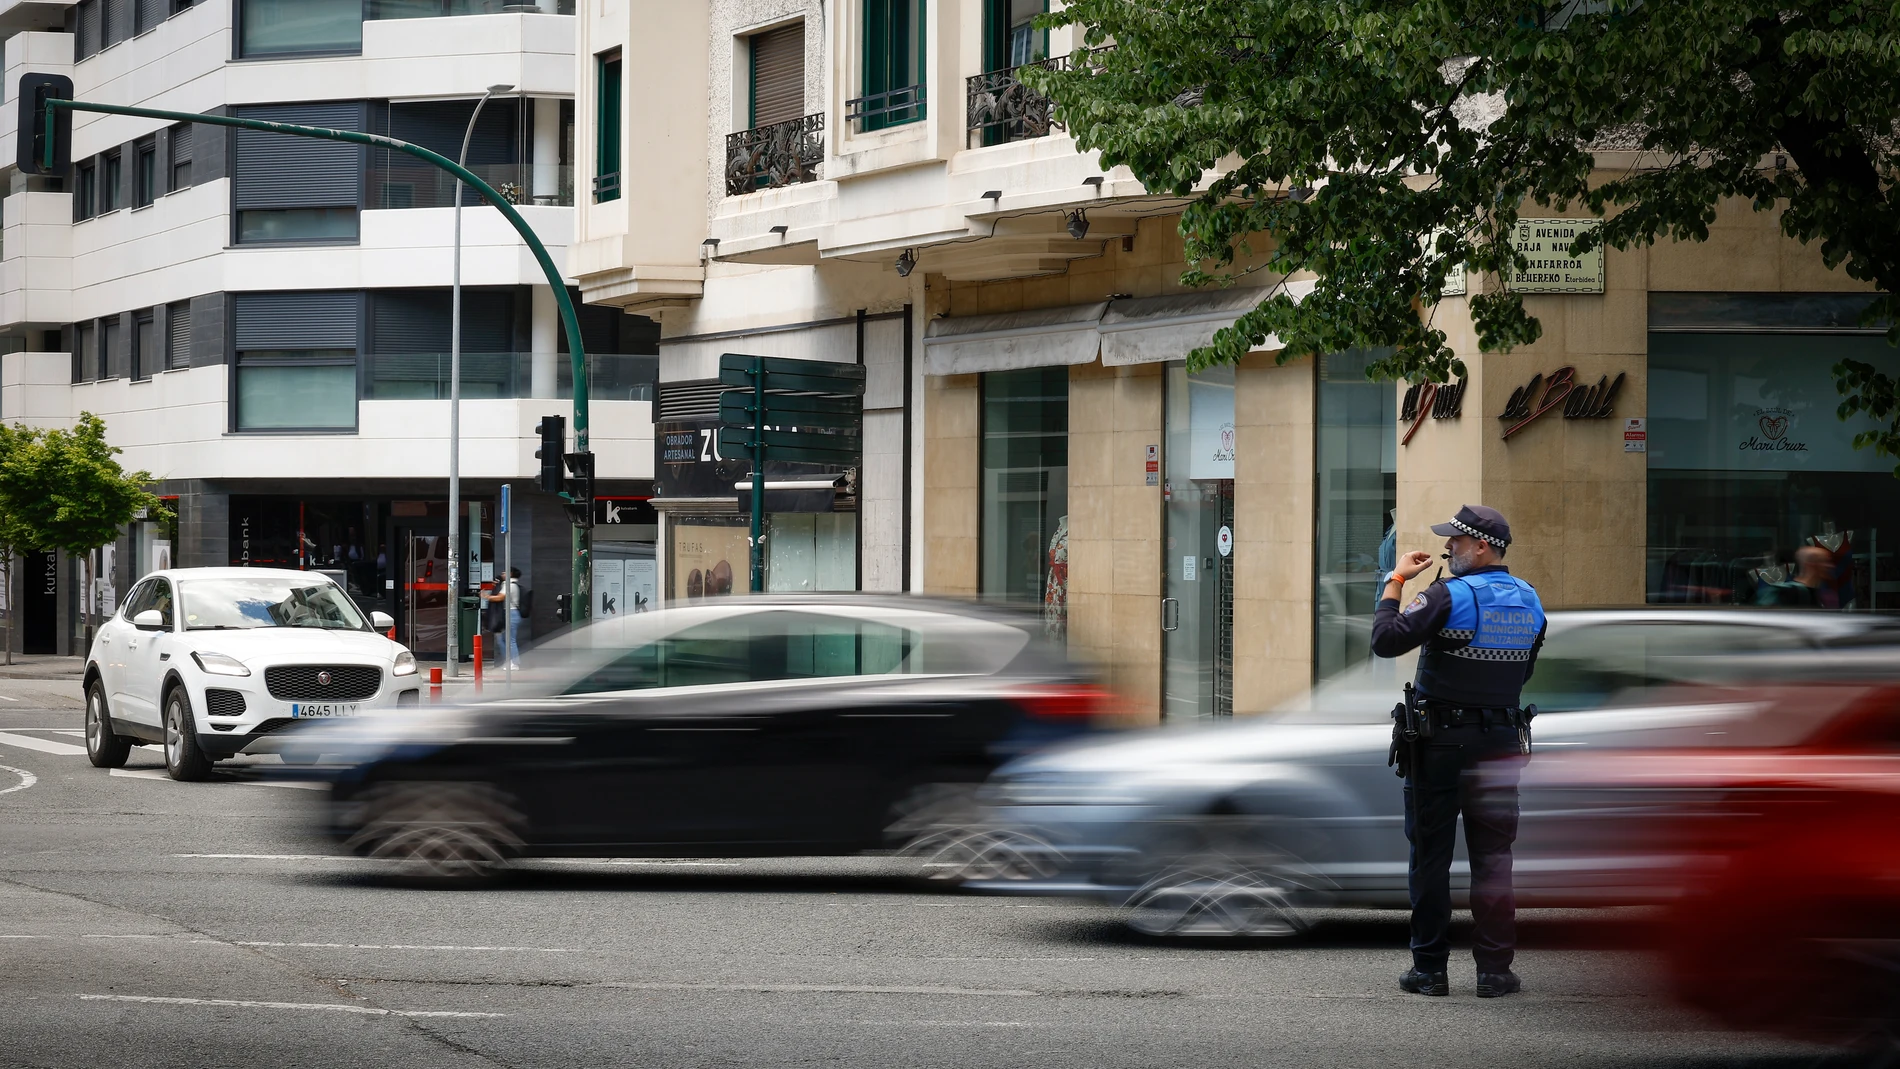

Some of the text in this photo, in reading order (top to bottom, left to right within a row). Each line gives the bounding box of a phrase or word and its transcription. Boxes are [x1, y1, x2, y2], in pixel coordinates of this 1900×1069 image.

[1536, 228, 1575, 238] AVENIDA
[1517, 242, 1542, 252] BAJA
[1529, 260, 1583, 269] NAFARROA
[1515, 273, 1561, 283] BEHEREKO
[666, 434, 693, 446] OBRADOR
[1739, 436, 1809, 452] Mari Cruz
[663, 448, 696, 460] ARTESANAL
[679, 541, 703, 553] TRUFAS
[1482, 610, 1535, 625] POLICIA
[1481, 623, 1535, 635] MUNICIPAL
[300, 704, 357, 717] 4645 LLY
